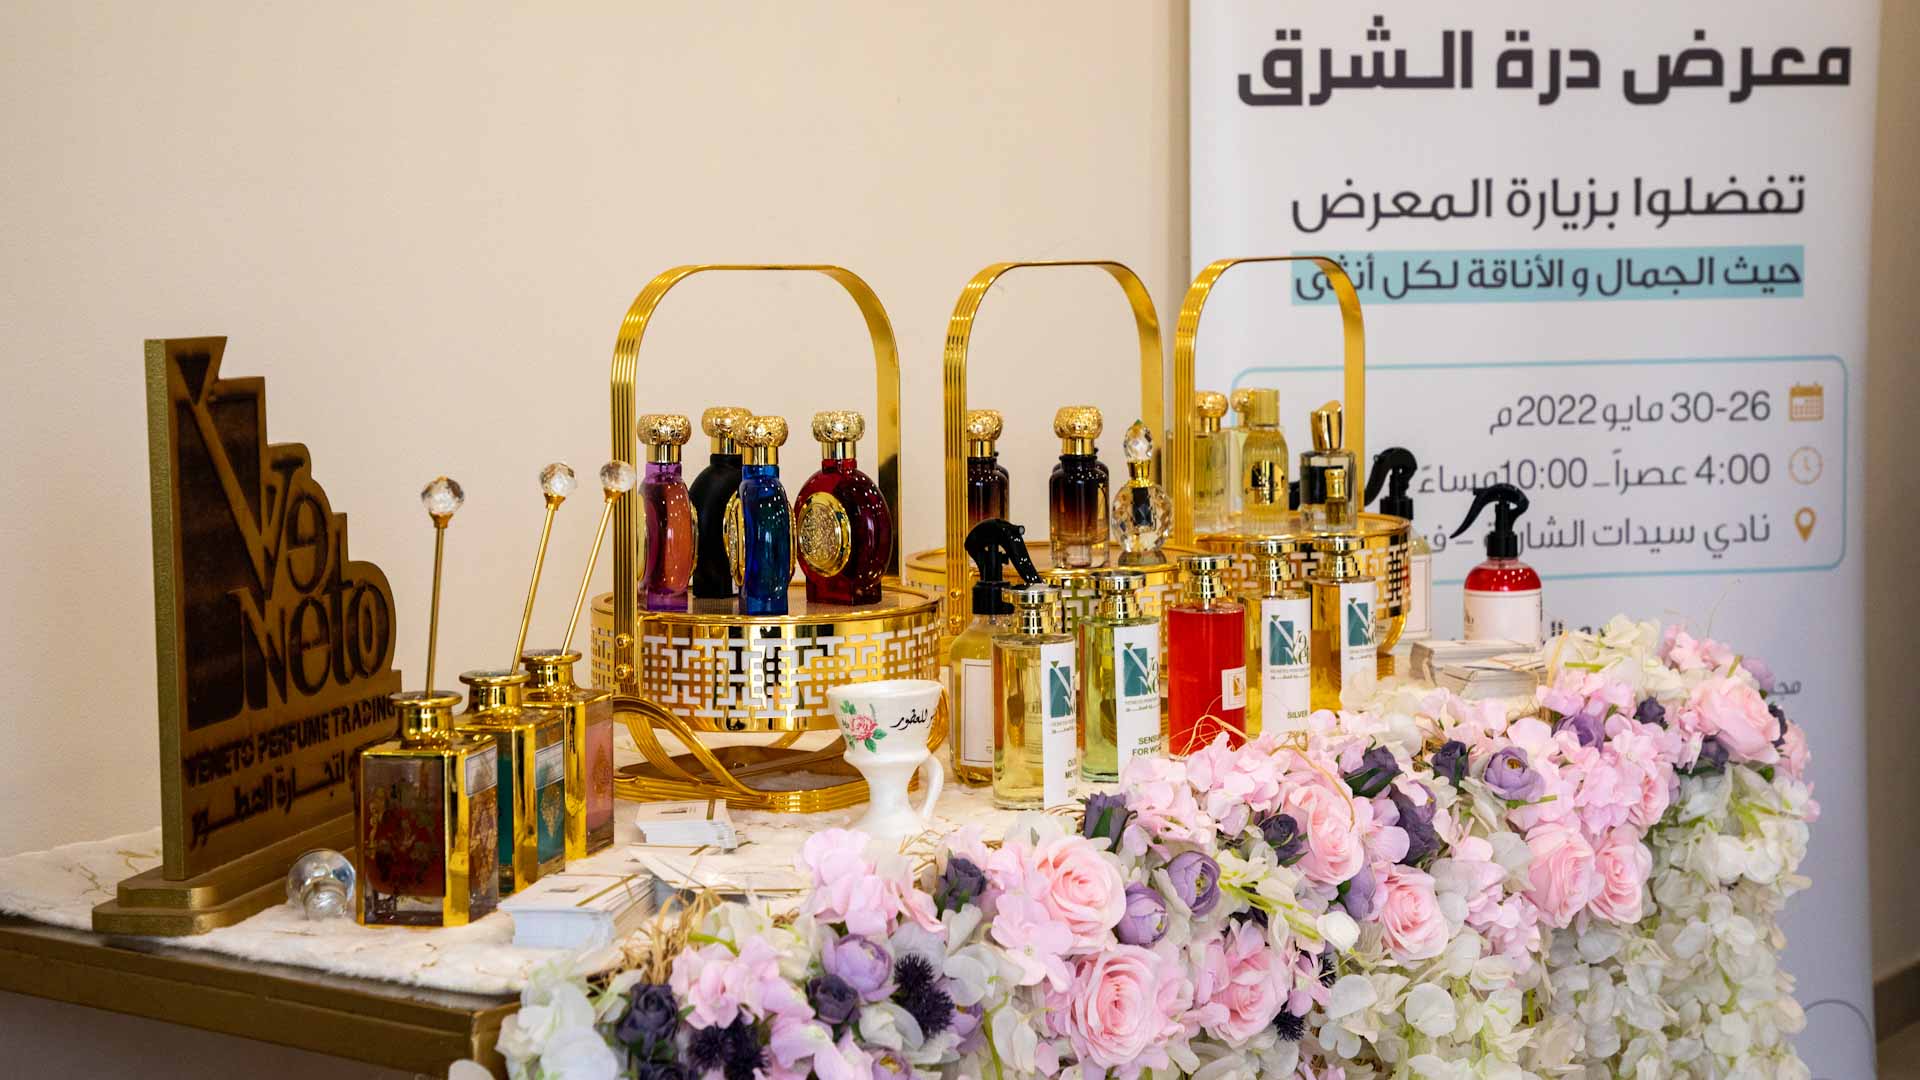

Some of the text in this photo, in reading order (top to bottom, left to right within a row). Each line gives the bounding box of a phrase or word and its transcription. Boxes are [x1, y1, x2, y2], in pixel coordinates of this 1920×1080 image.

[1238, 15, 1852, 106] معرض درة الشرق
[1292, 175, 1805, 234] تفضلوا بزيارة المعرض
[1383, 258, 1458, 299] لكل
[1597, 255, 1715, 297] الجمال
[1723, 255, 1802, 294] حيث
[1694, 453, 1771, 485] 4:00
[1592, 517, 1695, 554] سيدات
[1703, 514, 1770, 560] نادي
[185, 694, 397, 788] VENETO PERFUME TRADING
[1132, 747, 1149, 756] FOR
